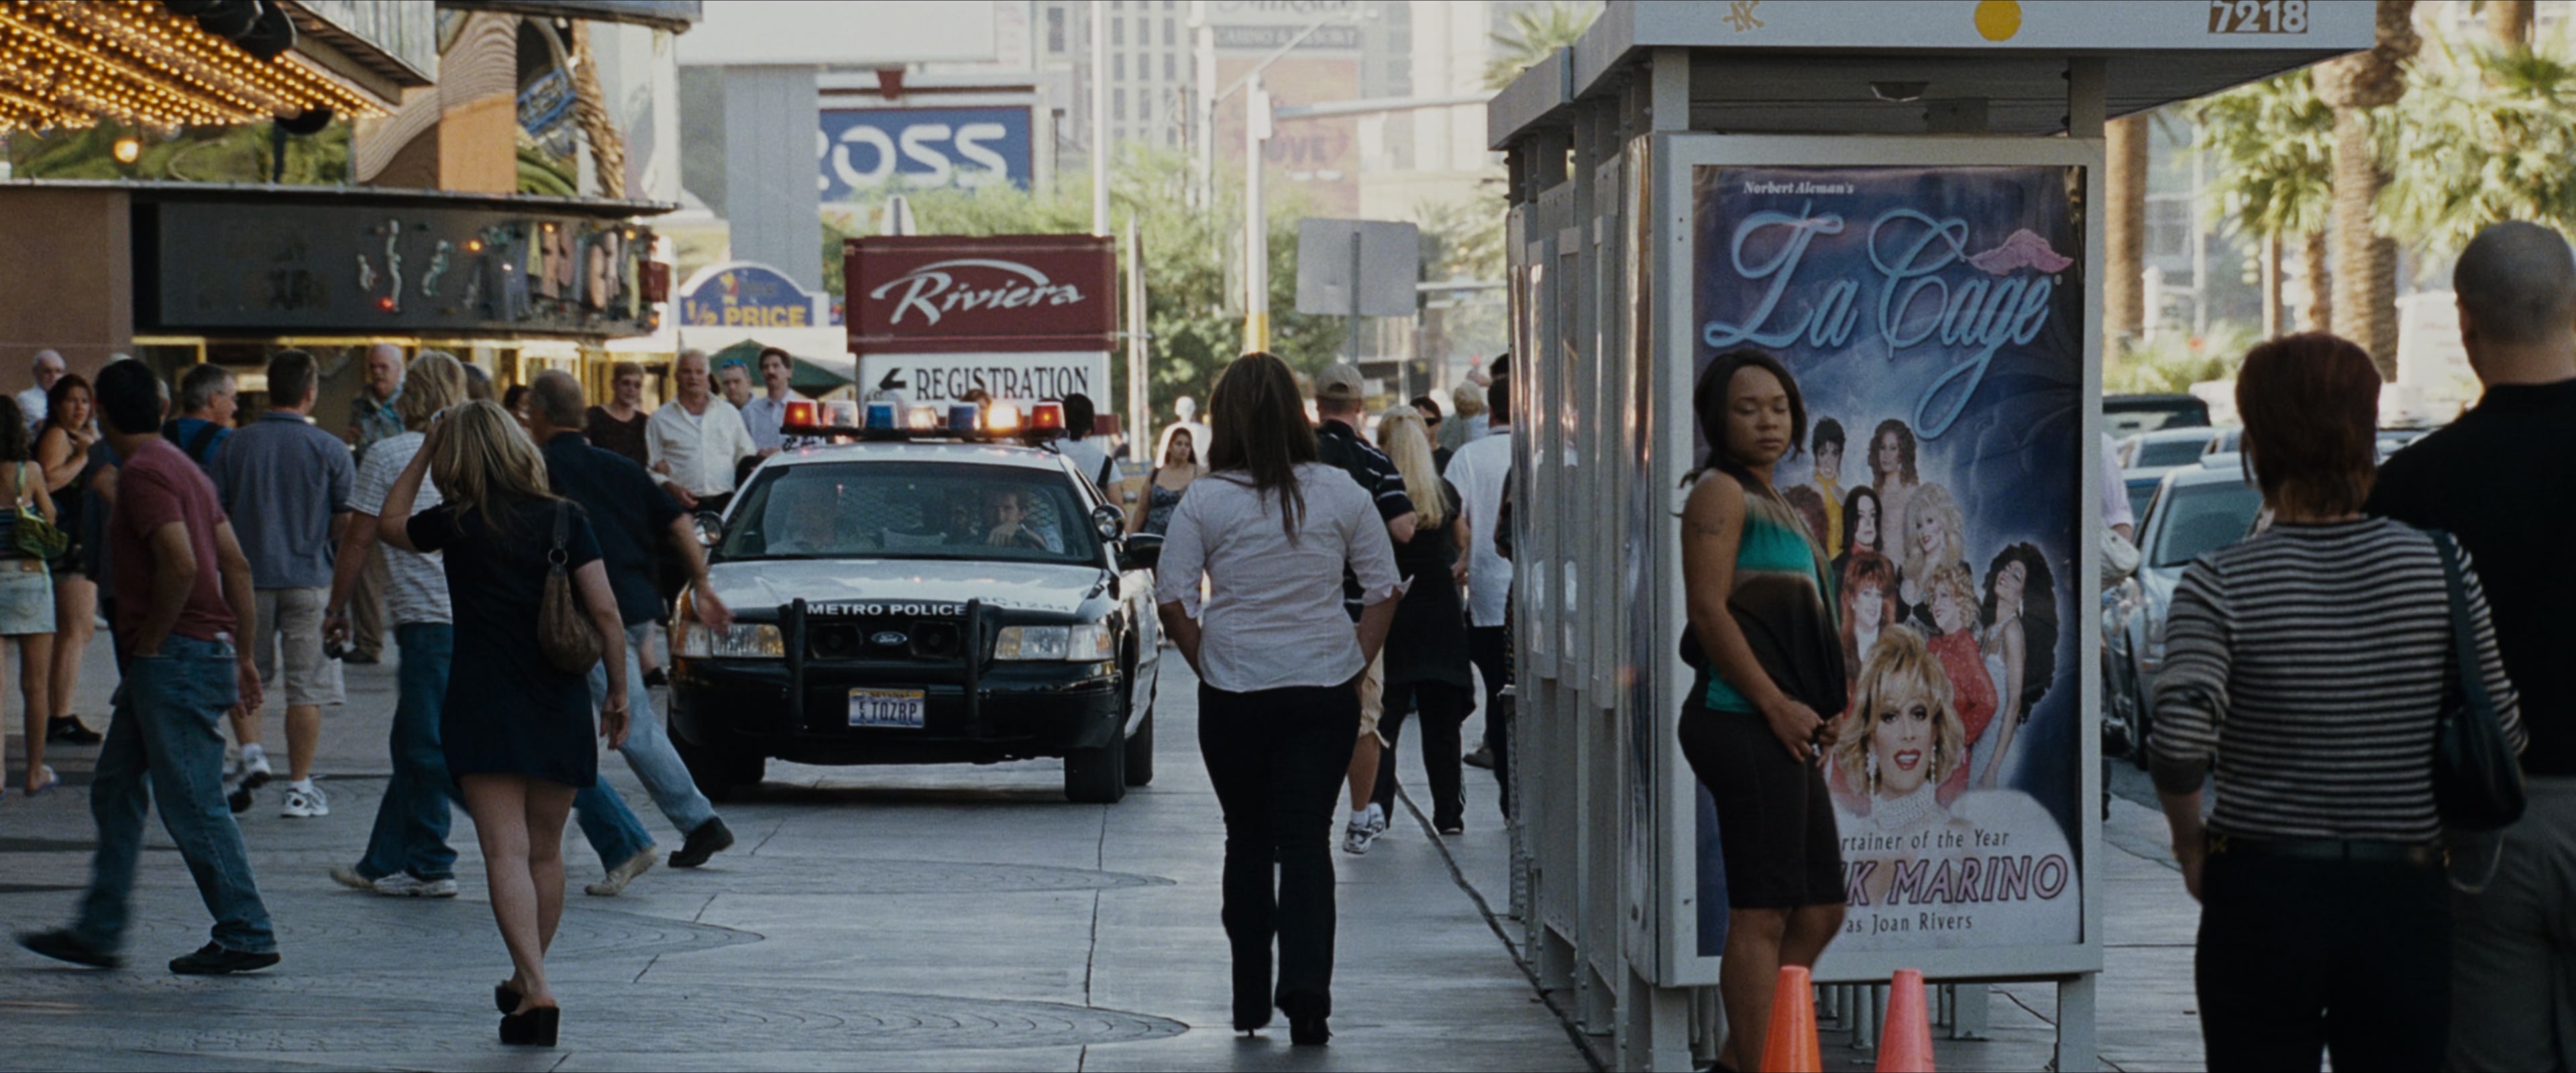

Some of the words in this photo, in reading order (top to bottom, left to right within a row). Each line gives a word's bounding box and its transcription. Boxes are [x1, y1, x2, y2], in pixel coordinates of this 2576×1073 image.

[2212, 1, 2306, 32] 7218
[1744, 182, 1794, 194] Norbert
[870, 259, 1085, 326] Riviera
[724, 305, 807, 327] PRICE
[1705, 198, 1859, 349] La
[1868, 208, 2053, 440] Cage
[915, 366, 1088, 400] REGISTRATION
[807, 604, 883, 616] METRO
[890, 604, 967, 616] POLICE
[1841, 832, 1902, 852] rtainer
[1912, 830, 1930, 849] of
[1937, 830, 1964, 848] the
[1975, 829, 2010, 847] Year
[1841, 861, 1878, 906] K
[1887, 854, 2068, 905] MARINO
[1846, 919, 1862, 933] as
[1872, 914, 1909, 936] Joan
[1919, 912, 1972, 930] Rivers
